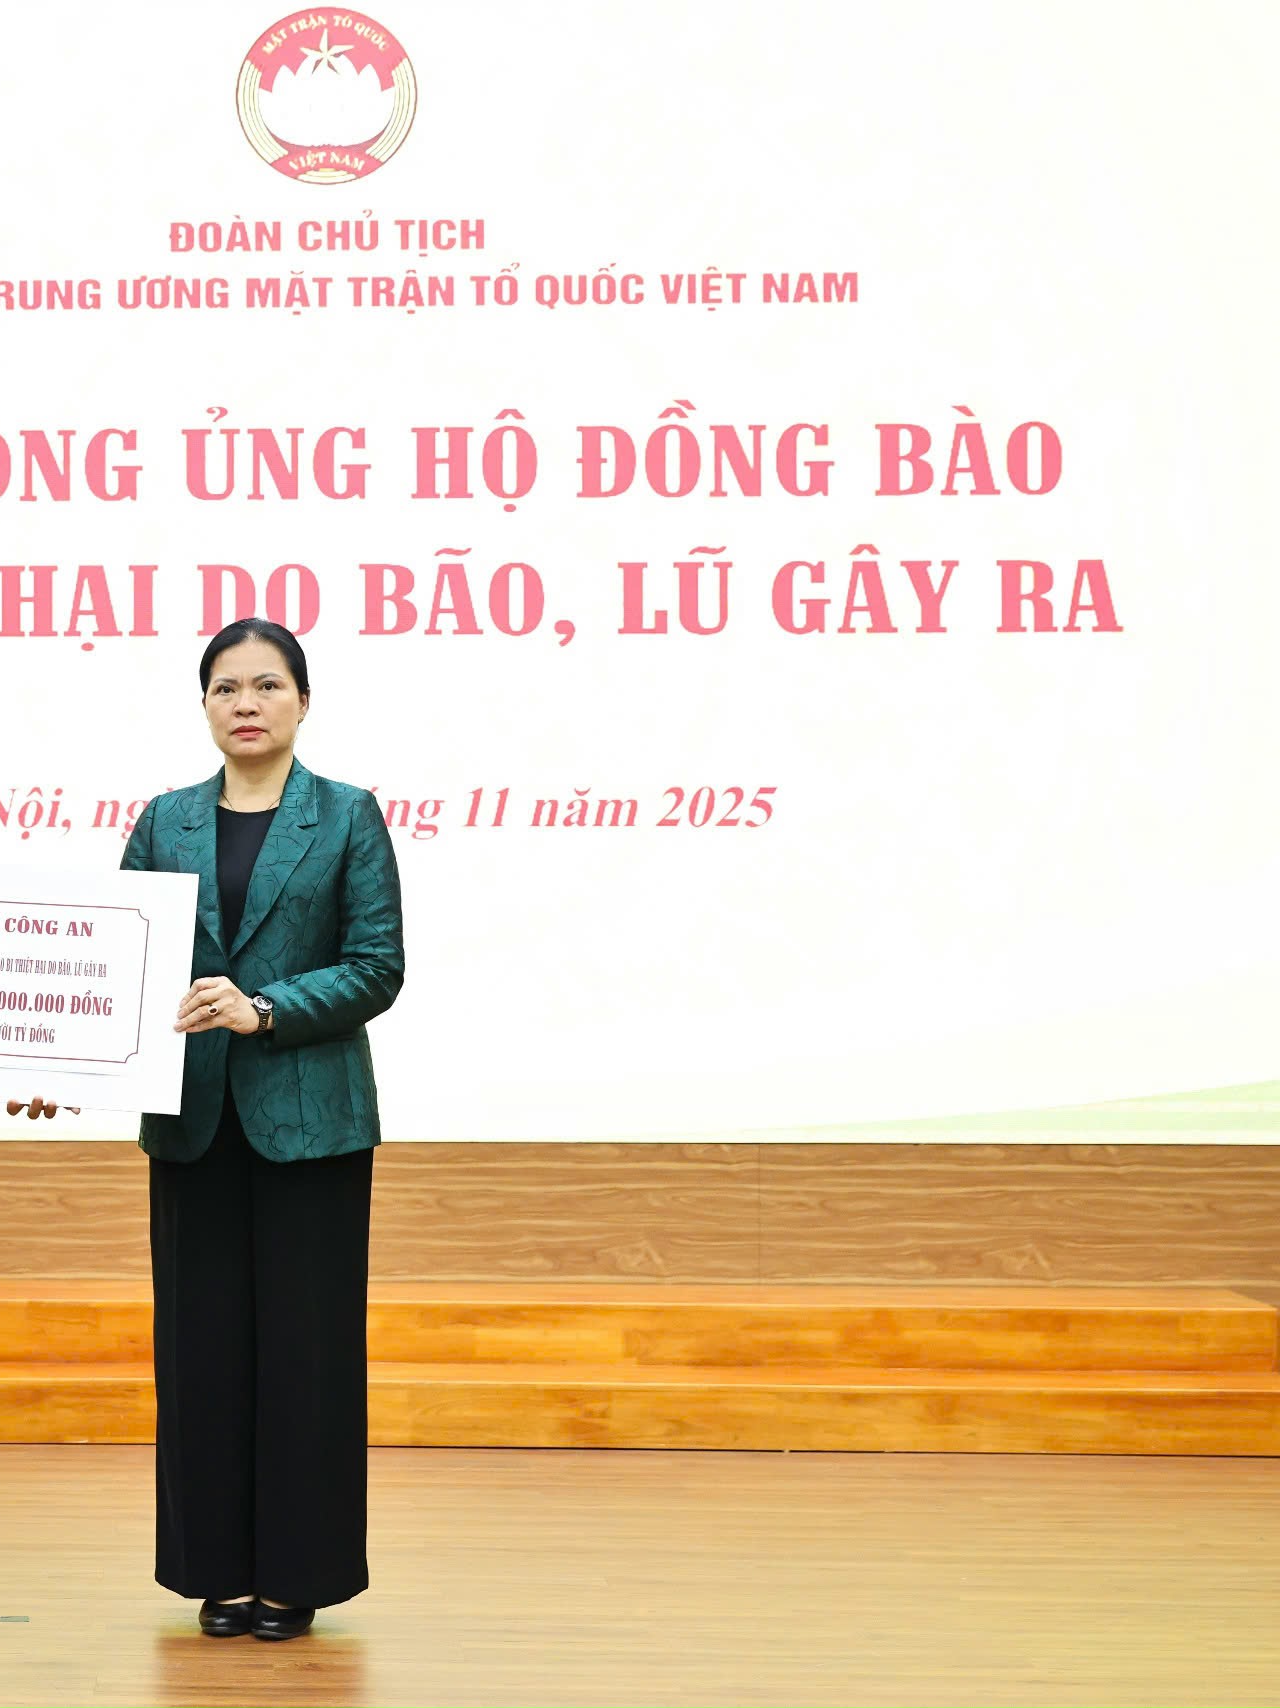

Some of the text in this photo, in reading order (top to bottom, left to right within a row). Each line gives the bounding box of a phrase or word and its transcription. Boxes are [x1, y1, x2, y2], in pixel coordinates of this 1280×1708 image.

[329, 151, 365, 171] NAM
[169, 209, 485, 257] ĐOÀN CHỦ TỊCH
[117, 275, 229, 310] ƯƠNG
[245, 270, 333, 316] MẶT
[347, 269, 455, 315] TRẬN
[470, 262, 520, 306] TỔ
[535, 262, 645, 310] QUỐC
[660, 266, 747, 312] VIỆT
[762, 271, 859, 304] NAM
[181, 406, 372, 501] ỦNG
[411, 408, 538, 513] HỘ
[576, 399, 835, 499] ĐỒNG
[874, 404, 1063, 497] BÀO
[197, 563, 322, 637] DO
[358, 546, 576, 647] BÃO,
[617, 545, 734, 636] LŨ
[771, 543, 960, 636] GÂY
[996, 559, 1124, 633] RA
[463, 787, 510, 828] 11
[528, 786, 639, 828] năm
[656, 786, 778, 828] 2025
[4, 915, 59, 936] CÔNG
[65, 920, 94, 938] AN
[47, 960, 57, 975] DO
[97, 963, 107, 978] RA
[69, 989, 113, 1017] ĐỒNG
